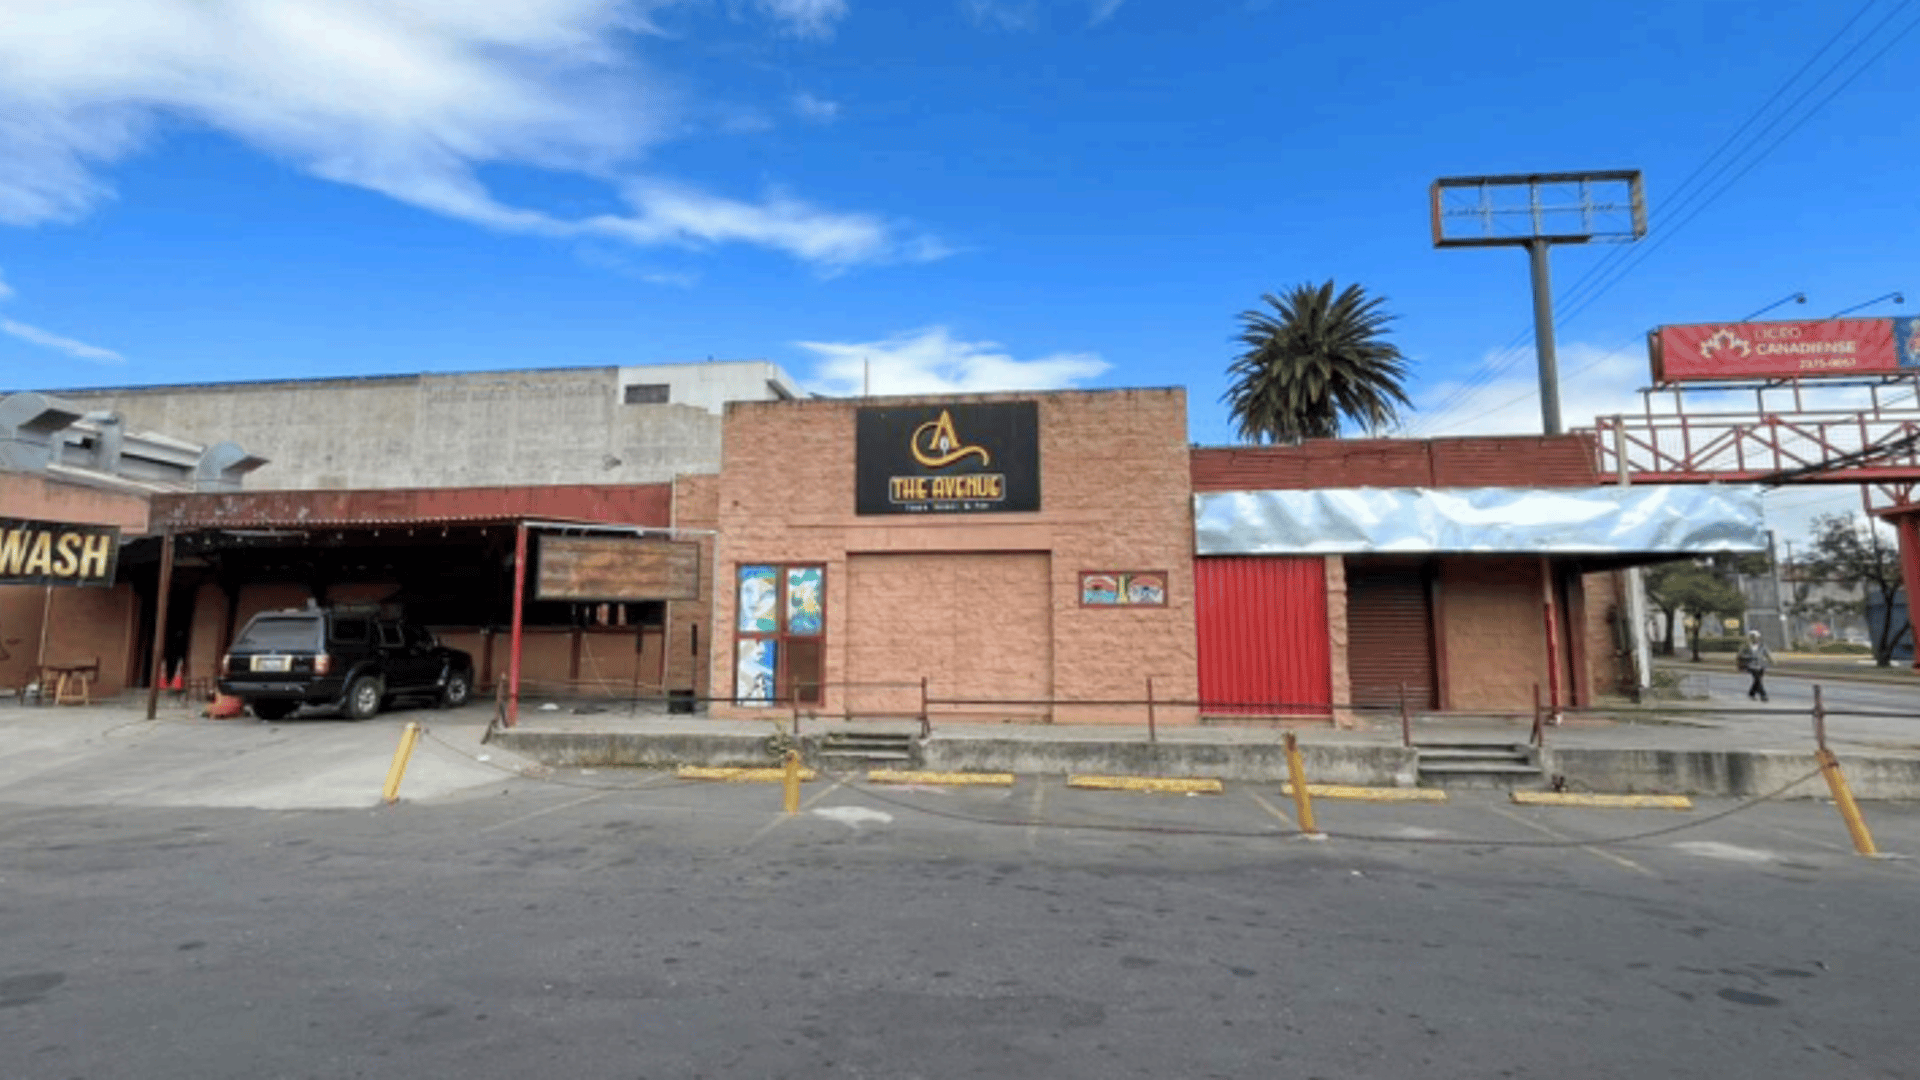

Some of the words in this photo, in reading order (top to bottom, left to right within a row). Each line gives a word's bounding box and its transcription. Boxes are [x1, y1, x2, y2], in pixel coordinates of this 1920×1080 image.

[1755, 340, 1857, 355] CANADIENSE
[892, 477, 928, 499] THE
[932, 475, 1000, 497] AVENUE
[0, 528, 110, 577] WASH
